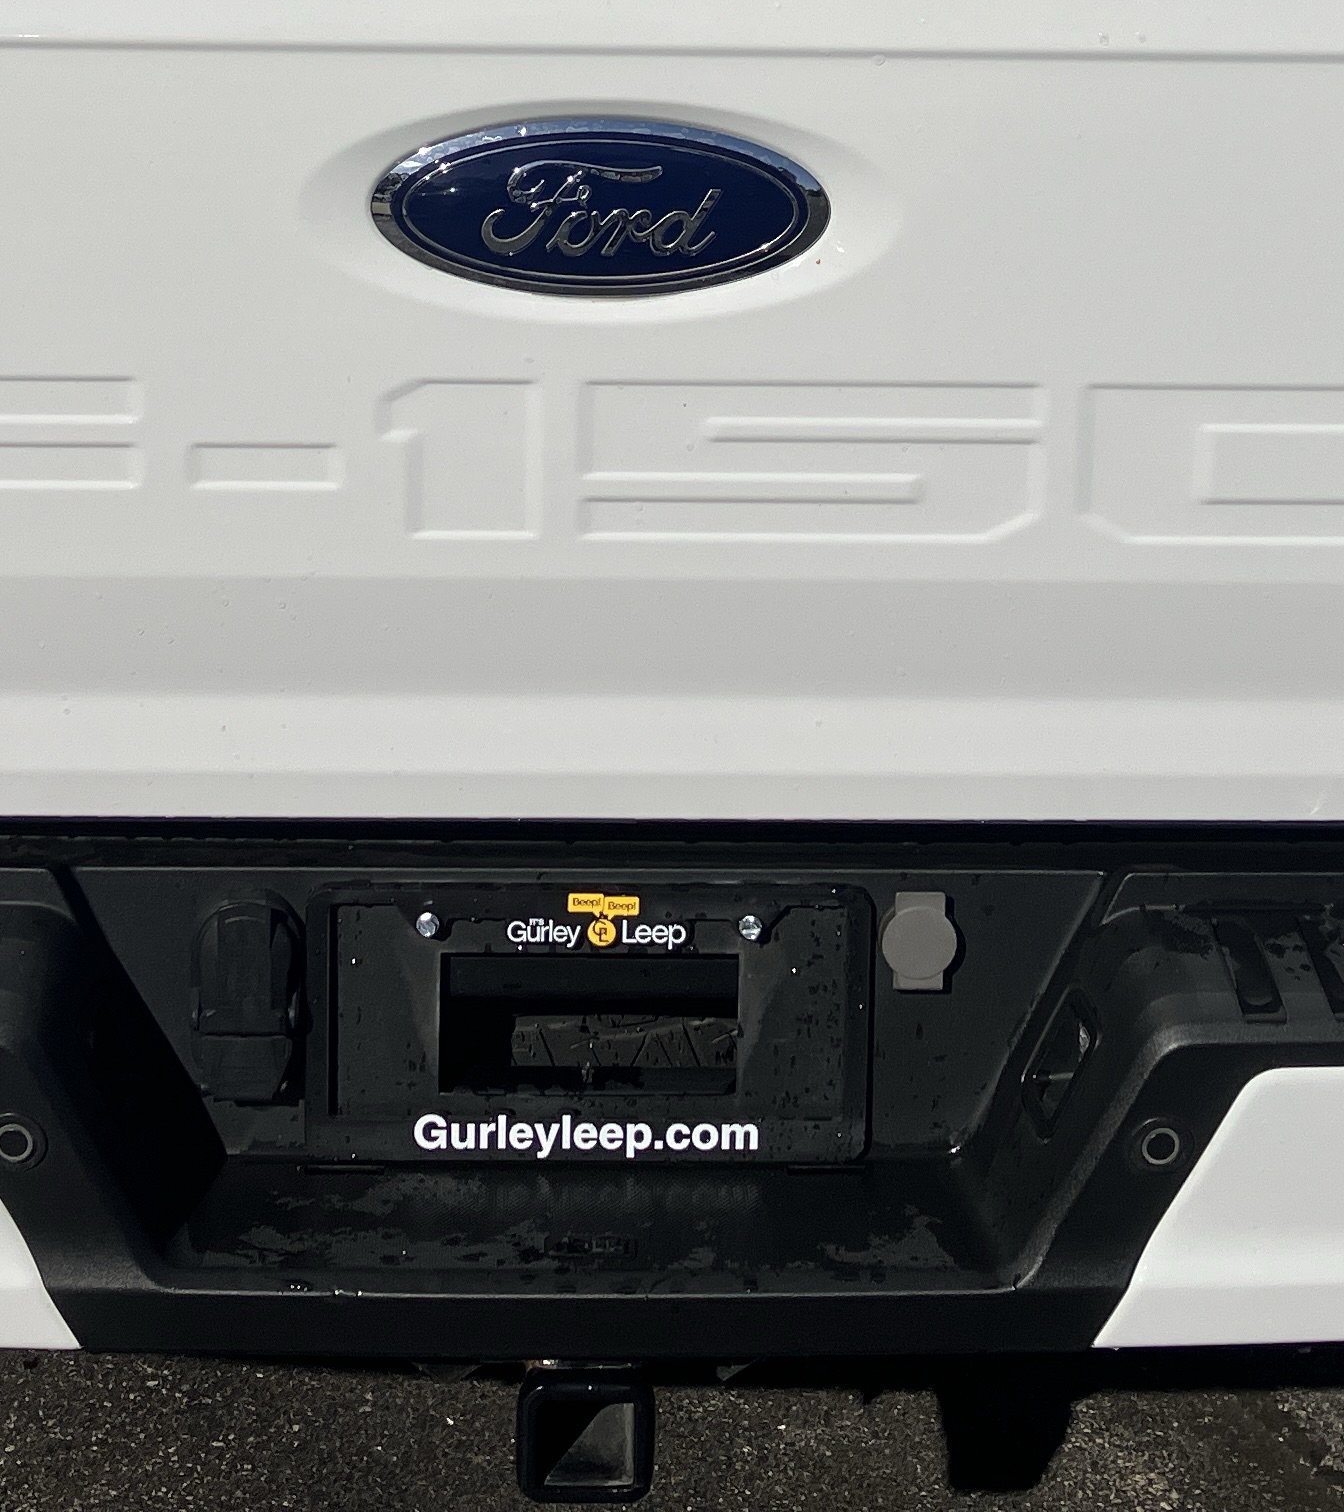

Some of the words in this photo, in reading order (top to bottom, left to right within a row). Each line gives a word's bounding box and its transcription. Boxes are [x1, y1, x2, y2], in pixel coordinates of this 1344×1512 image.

[481, 159, 722, 257] Ford
[572, 897, 602, 909] Beep!
[607, 901, 636, 912] Beep!
[507, 919, 581, 948] Gurley
[622, 919, 687, 950] Leep
[413, 1114, 759, 1158] Gurleyleep.com
